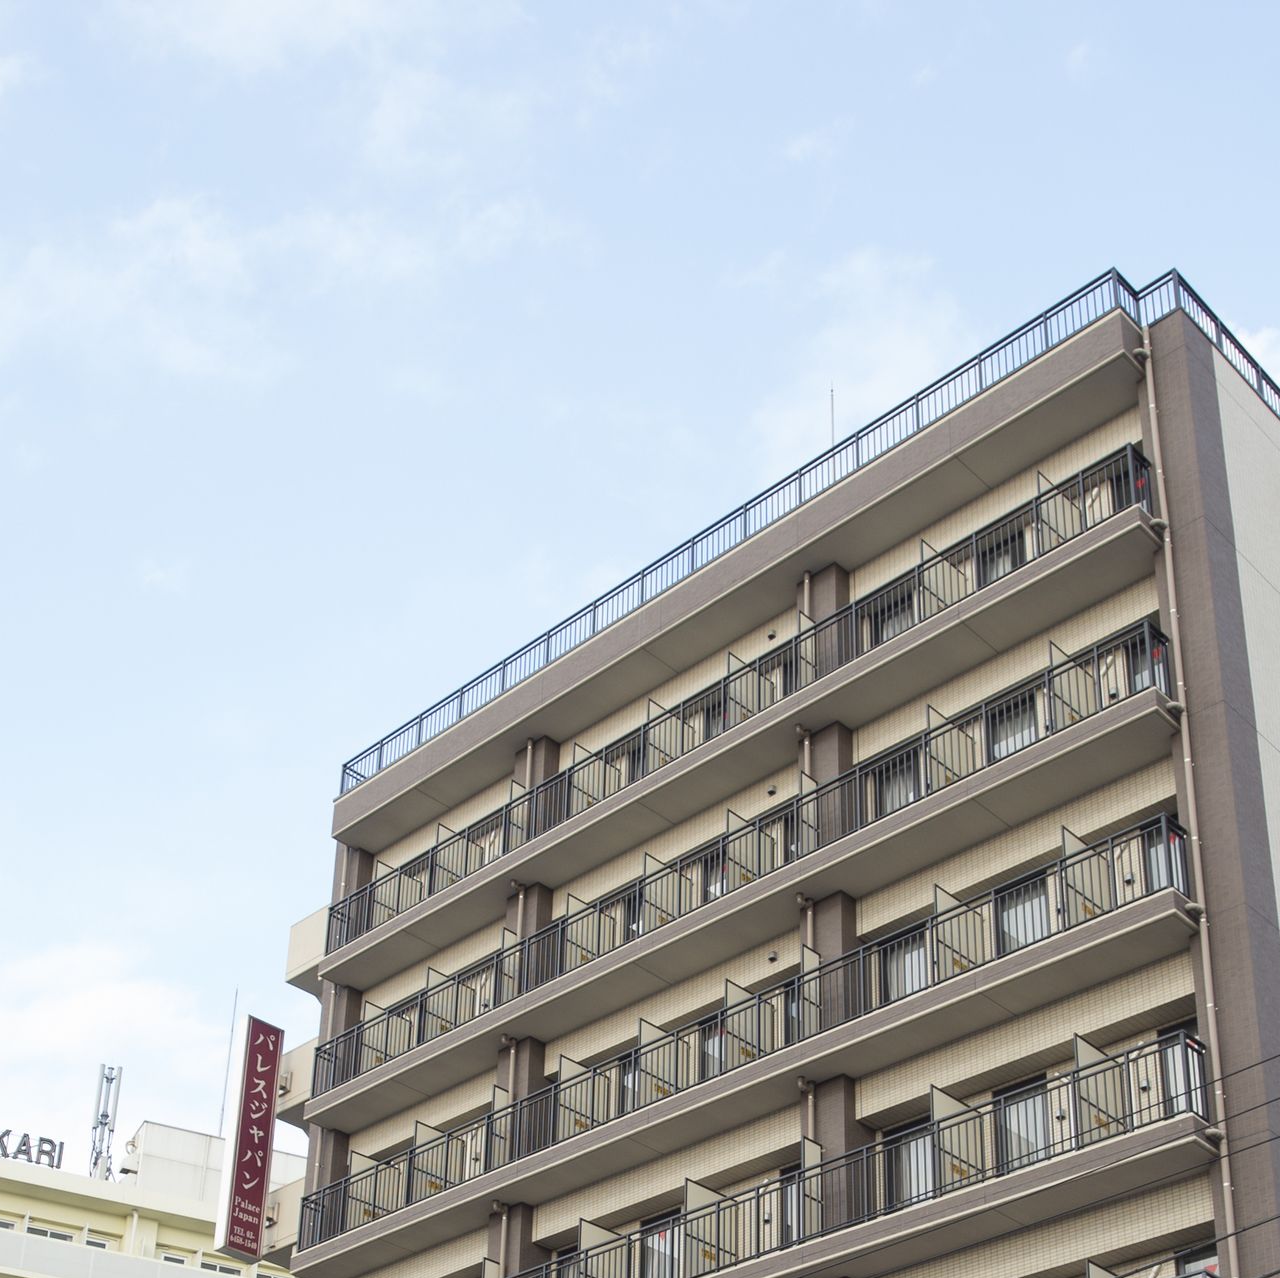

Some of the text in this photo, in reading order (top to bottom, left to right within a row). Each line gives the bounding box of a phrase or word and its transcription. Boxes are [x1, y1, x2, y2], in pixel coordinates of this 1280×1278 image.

[240, 1032, 276, 1190] パレスジャパン
[234, 1195, 261, 1214] Palace
[232, 1207, 259, 1225] Japan
[233, 1225, 246, 1237] TEL
